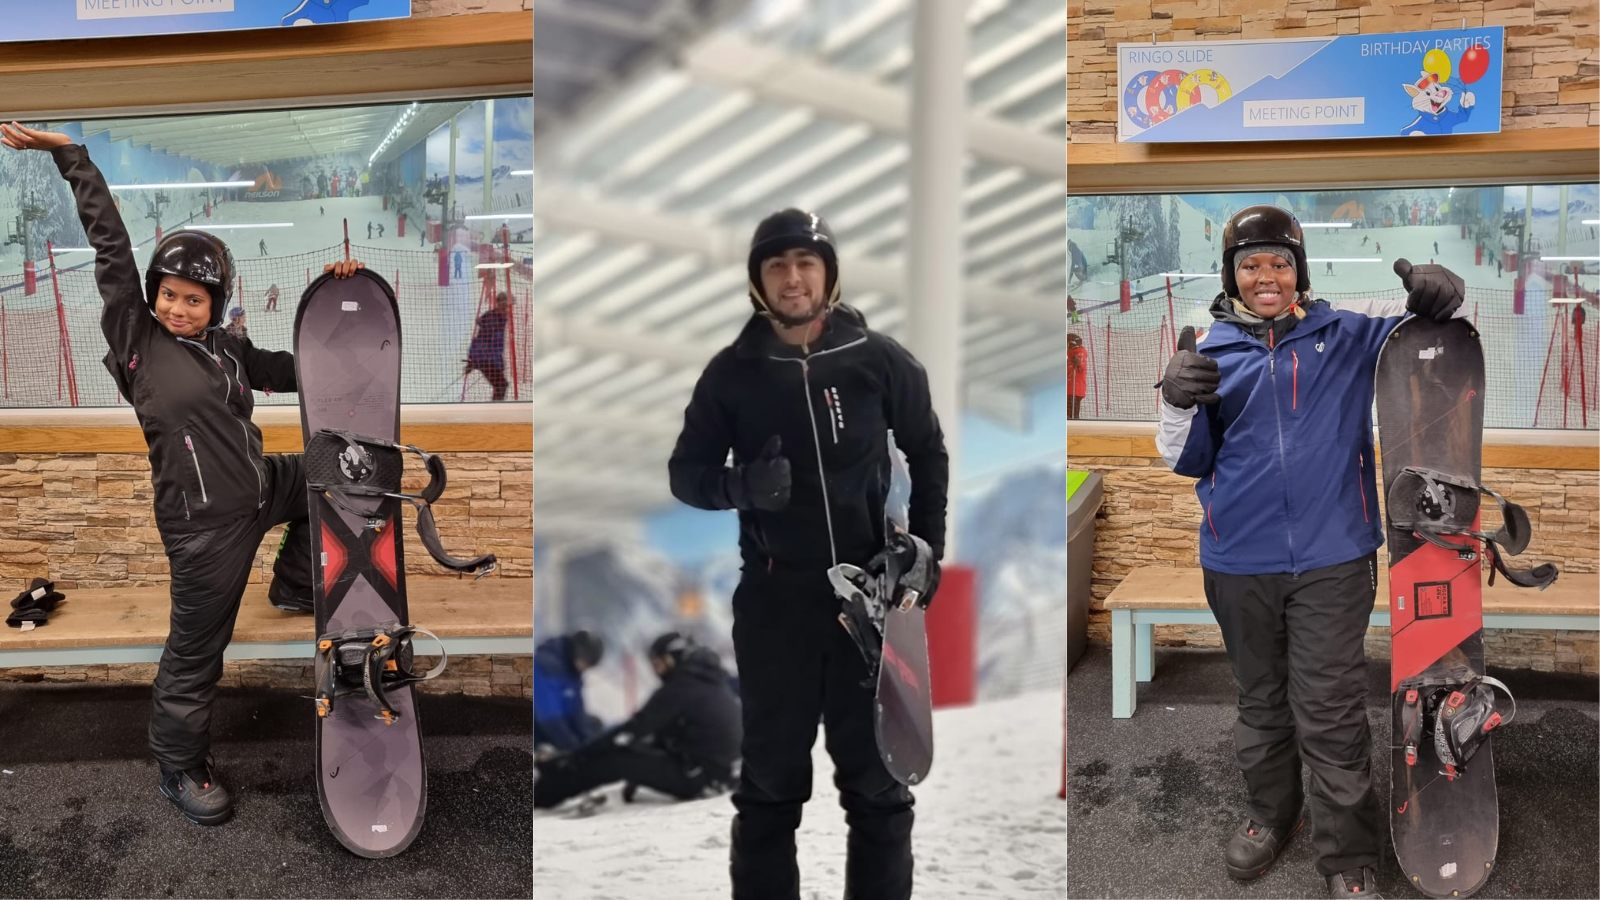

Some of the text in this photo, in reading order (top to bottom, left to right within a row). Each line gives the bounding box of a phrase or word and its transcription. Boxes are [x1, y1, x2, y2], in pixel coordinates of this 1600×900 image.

[1361, 36, 1491, 56] BIRTHDAY PARTIES
[1129, 49, 1213, 63] RINGO SLIDE
[1249, 104, 1358, 120] MEETING POINT
